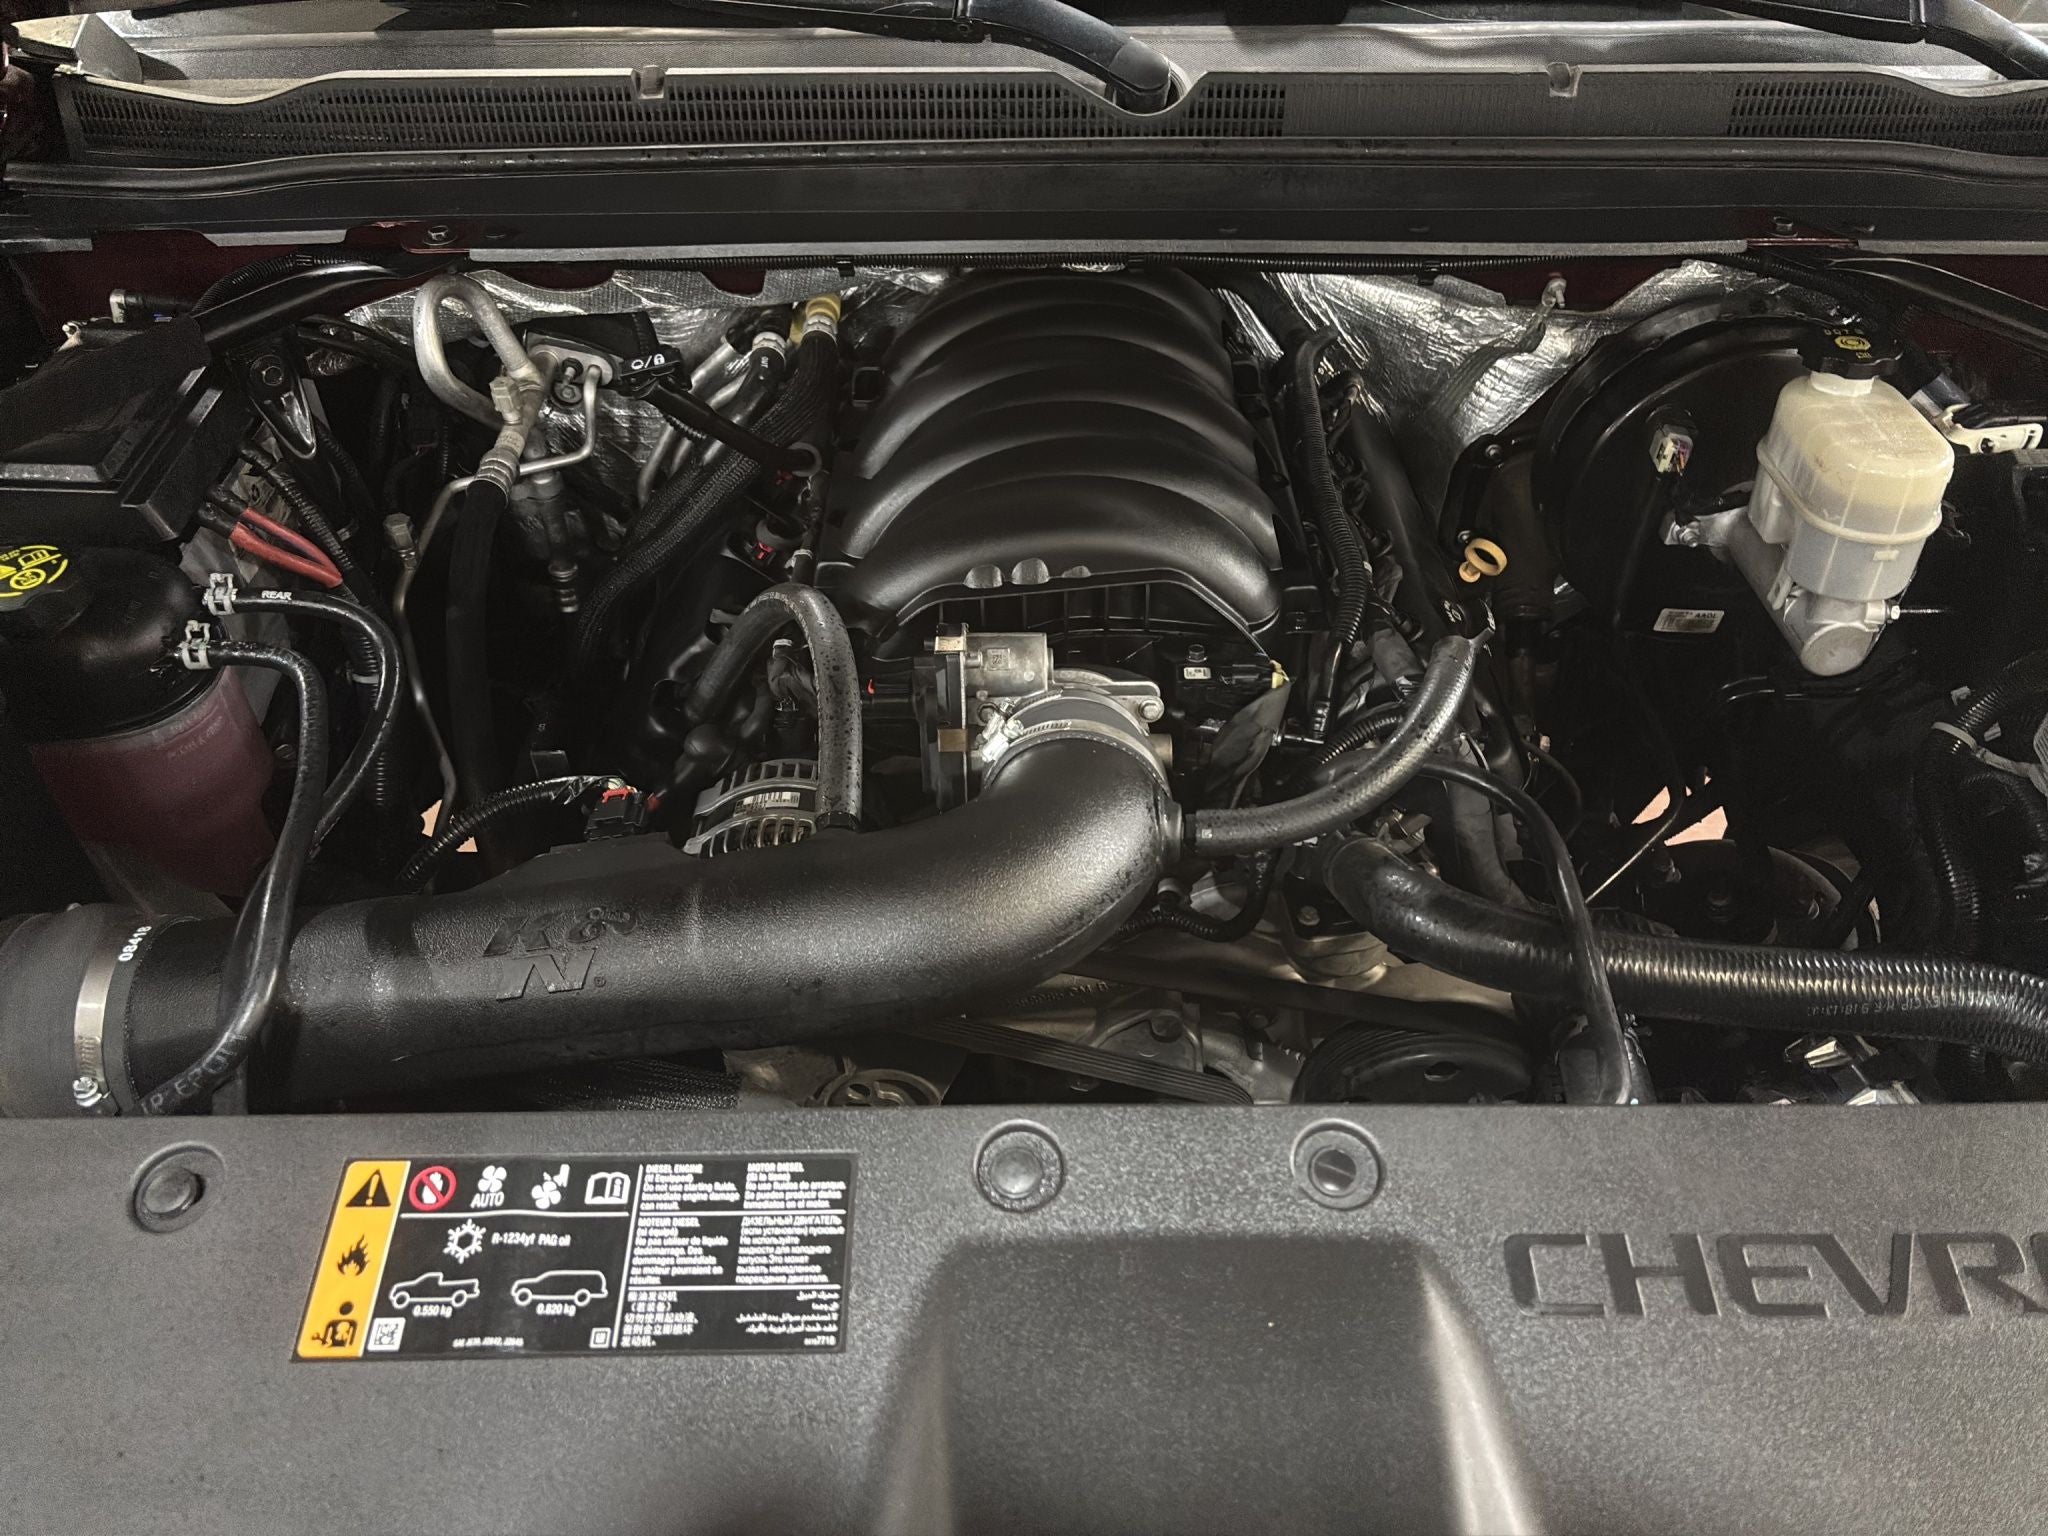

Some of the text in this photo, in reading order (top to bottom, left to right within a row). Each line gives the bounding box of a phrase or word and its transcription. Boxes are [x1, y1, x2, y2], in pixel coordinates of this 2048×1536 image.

[261, 590, 292, 601] REAR
[118, 925, 152, 962] 08418
[470, 1191, 505, 1209] AUTO
[491, 1232, 571, 1247] R-1234yf PAG oil
[413, 1304, 452, 1318] 0.550 kg
[536, 1303, 576, 1317] 0.820 kg
